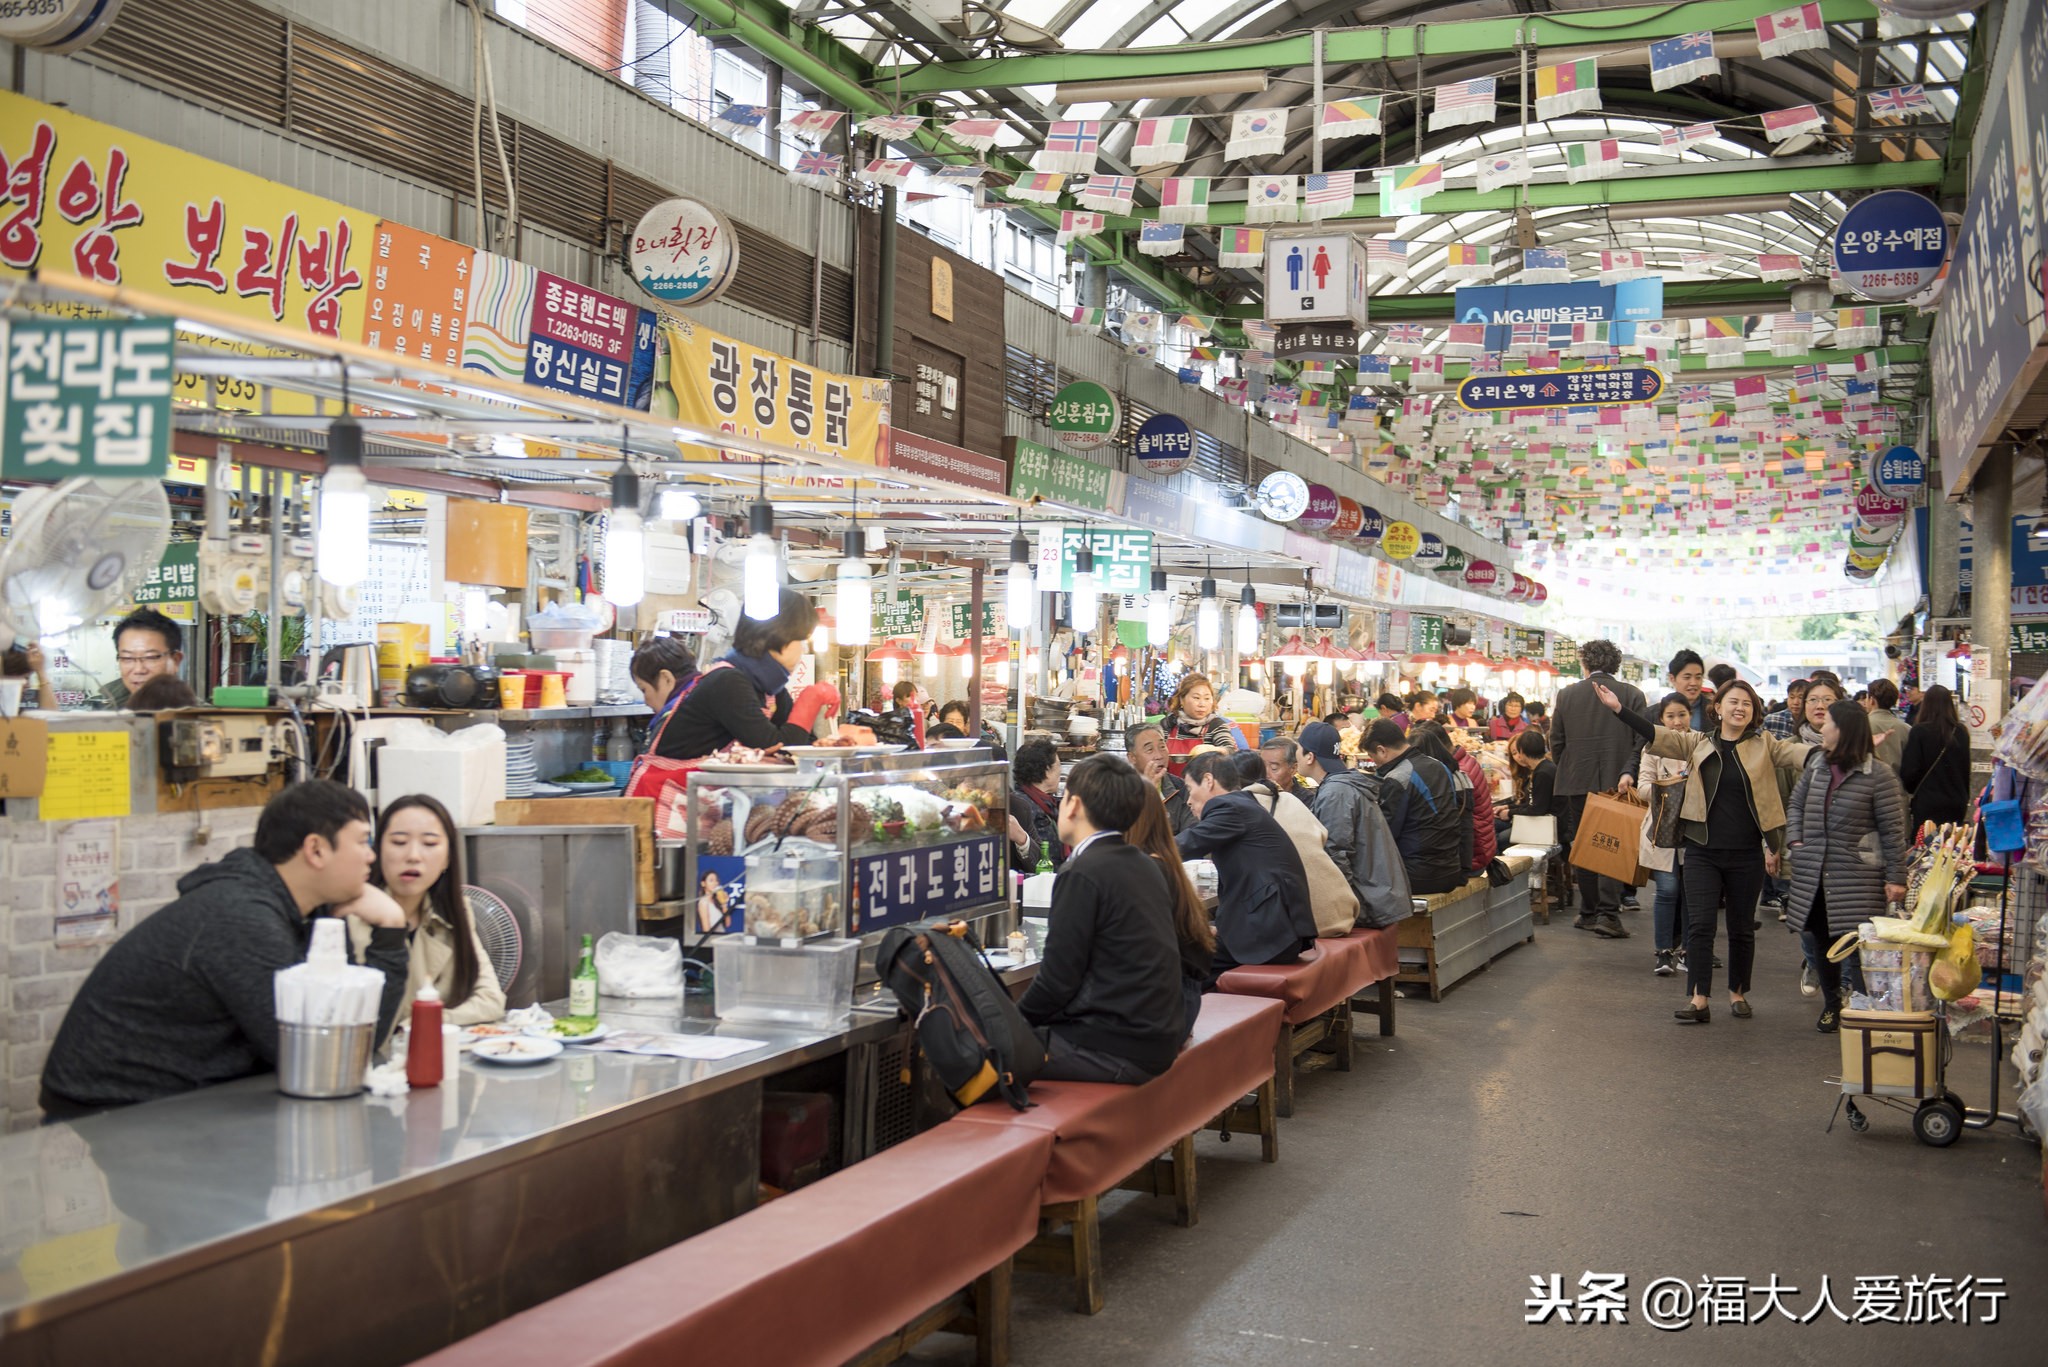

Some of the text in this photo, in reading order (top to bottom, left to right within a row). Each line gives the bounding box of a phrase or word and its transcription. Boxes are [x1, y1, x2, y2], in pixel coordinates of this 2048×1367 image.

[0, 0, 64, 18] 65-9351
[1840, 227, 1942, 254] 온양수예점
[163, 195, 365, 345] 보리밥
[1862, 271, 1919, 287] 2266-6369
[653, 281, 698, 291] 2266-2868
[547, 317, 623, 354] T.2263-0155 3F
[1311, 333, 1344, 347] 남1문
[10, 329, 173, 401] 전라도
[531, 340, 623, 398] 명신실크
[708, 339, 853, 448] 광장통닭
[1469, 384, 1536, 401] 우리은행
[1053, 401, 1111, 426] 신혼침구
[22, 403, 155, 466] 횟집
[1138, 433, 1190, 453] 솔비주단
[1883, 459, 1922, 479] 송월타올
[1043, 549, 1058, 561] 23
[136, 585, 196, 602] 2267 5478
[868, 842, 995, 919] 전라도횟집
